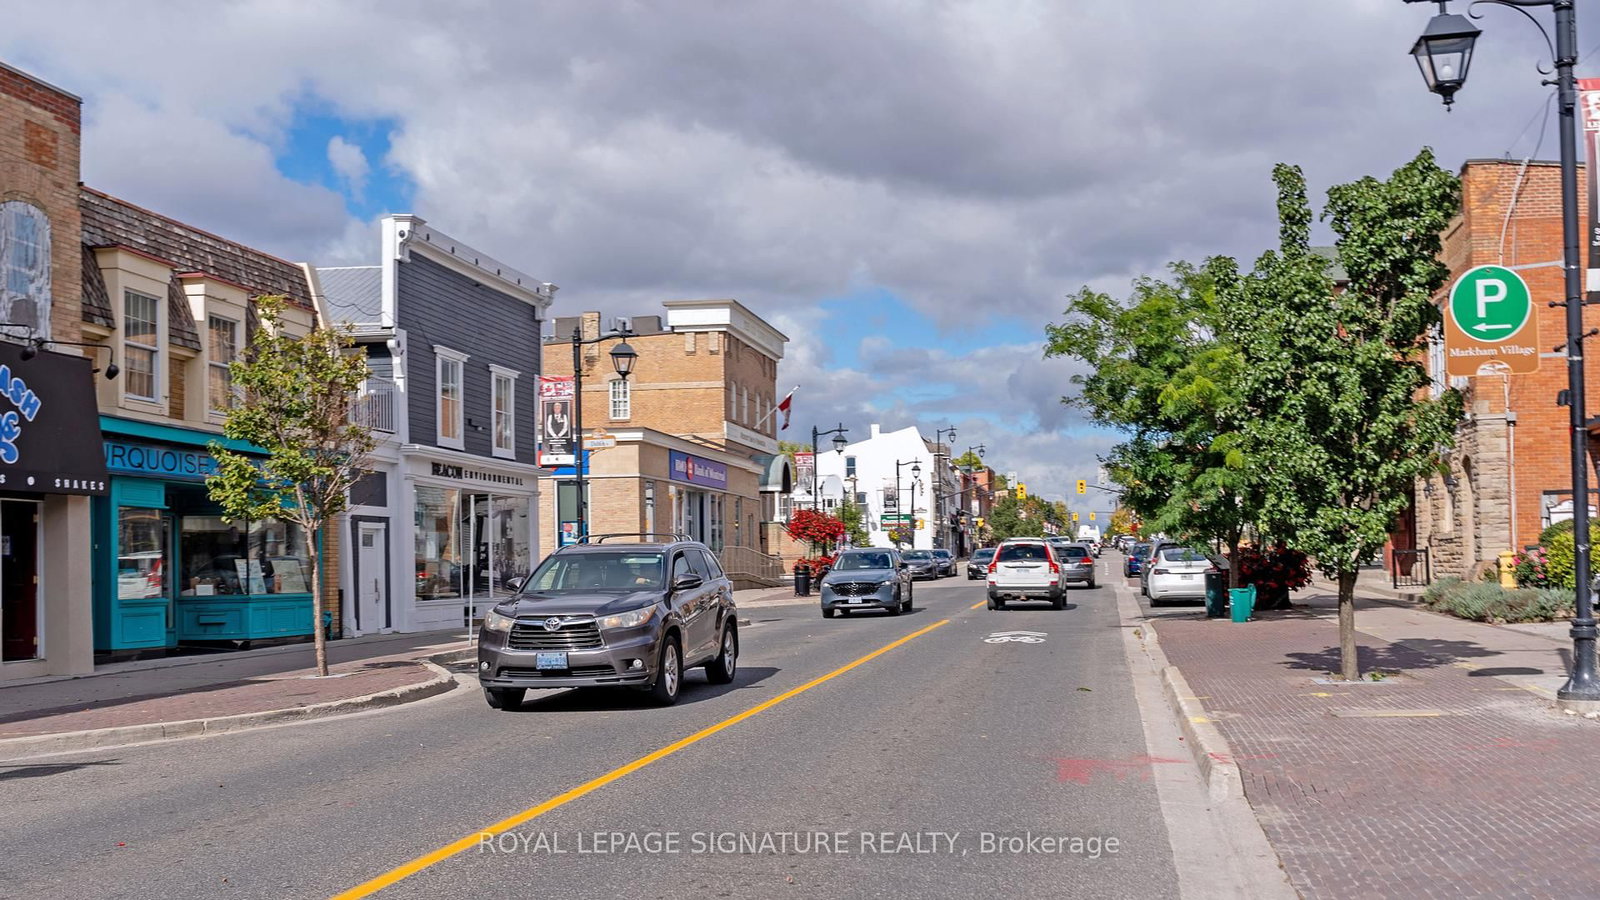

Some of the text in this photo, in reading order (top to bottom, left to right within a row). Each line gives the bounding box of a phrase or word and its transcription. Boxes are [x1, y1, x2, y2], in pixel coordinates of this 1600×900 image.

[1475, 278, 1508, 318] P
[1449, 345, 1536, 357] Markham Village
[431, 461, 524, 486] BEACON ENVIRONMENTAL
[55, 478, 105, 491] SHAKES
